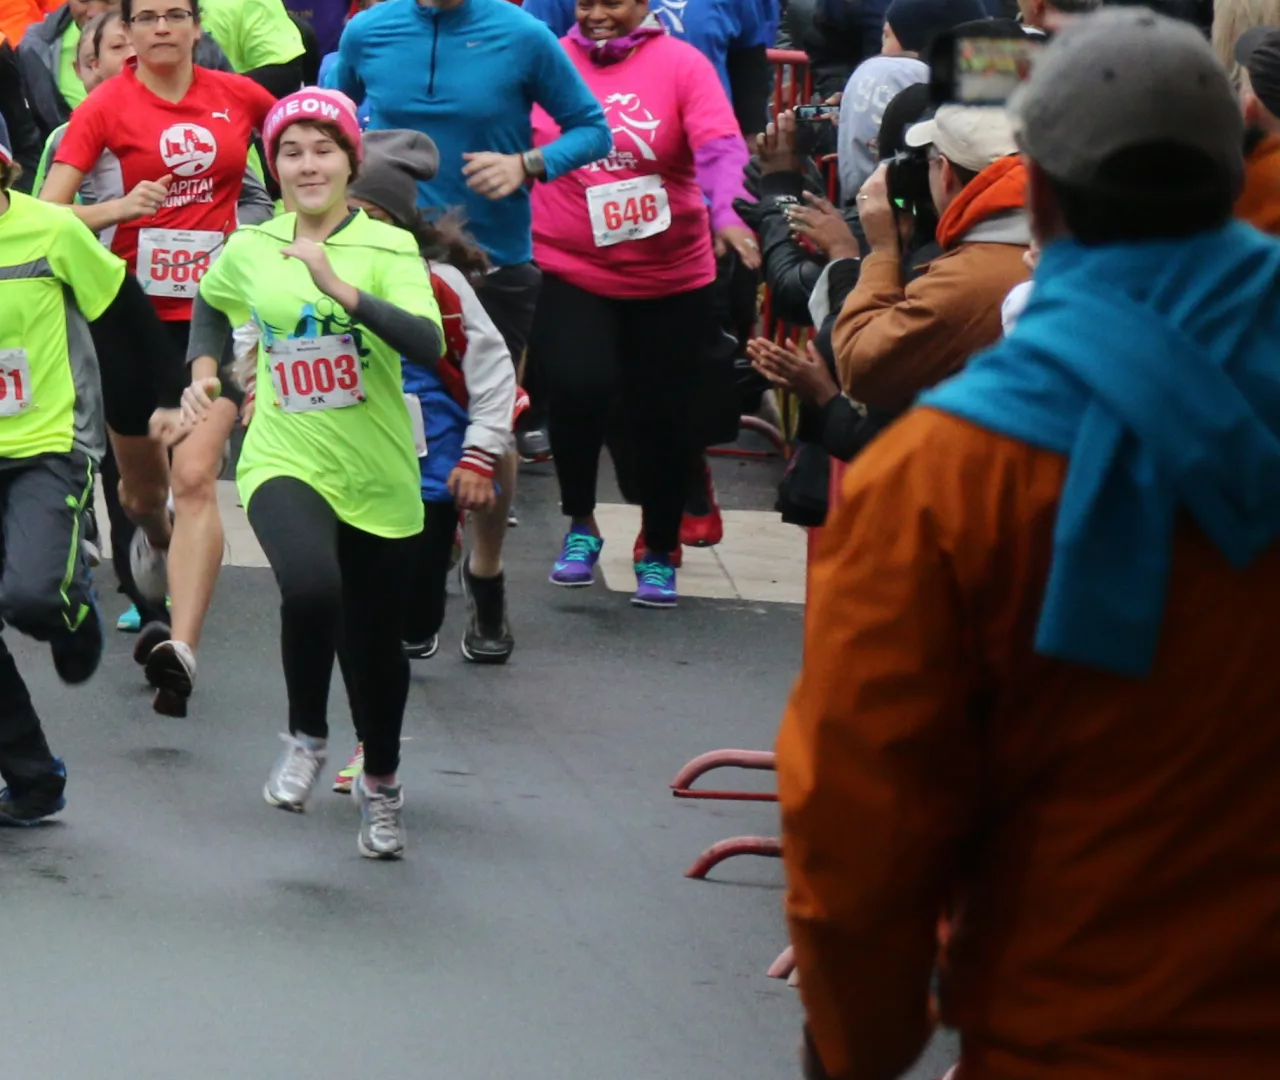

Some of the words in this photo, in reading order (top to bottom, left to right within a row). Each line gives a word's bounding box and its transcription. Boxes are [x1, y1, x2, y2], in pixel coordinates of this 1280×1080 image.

[271, 98, 340, 127] MEOW
[603, 194, 658, 231] 646
[150, 248, 211, 283] 588
[173, 284, 187, 292] 5K
[275, 354, 359, 398] 1003
